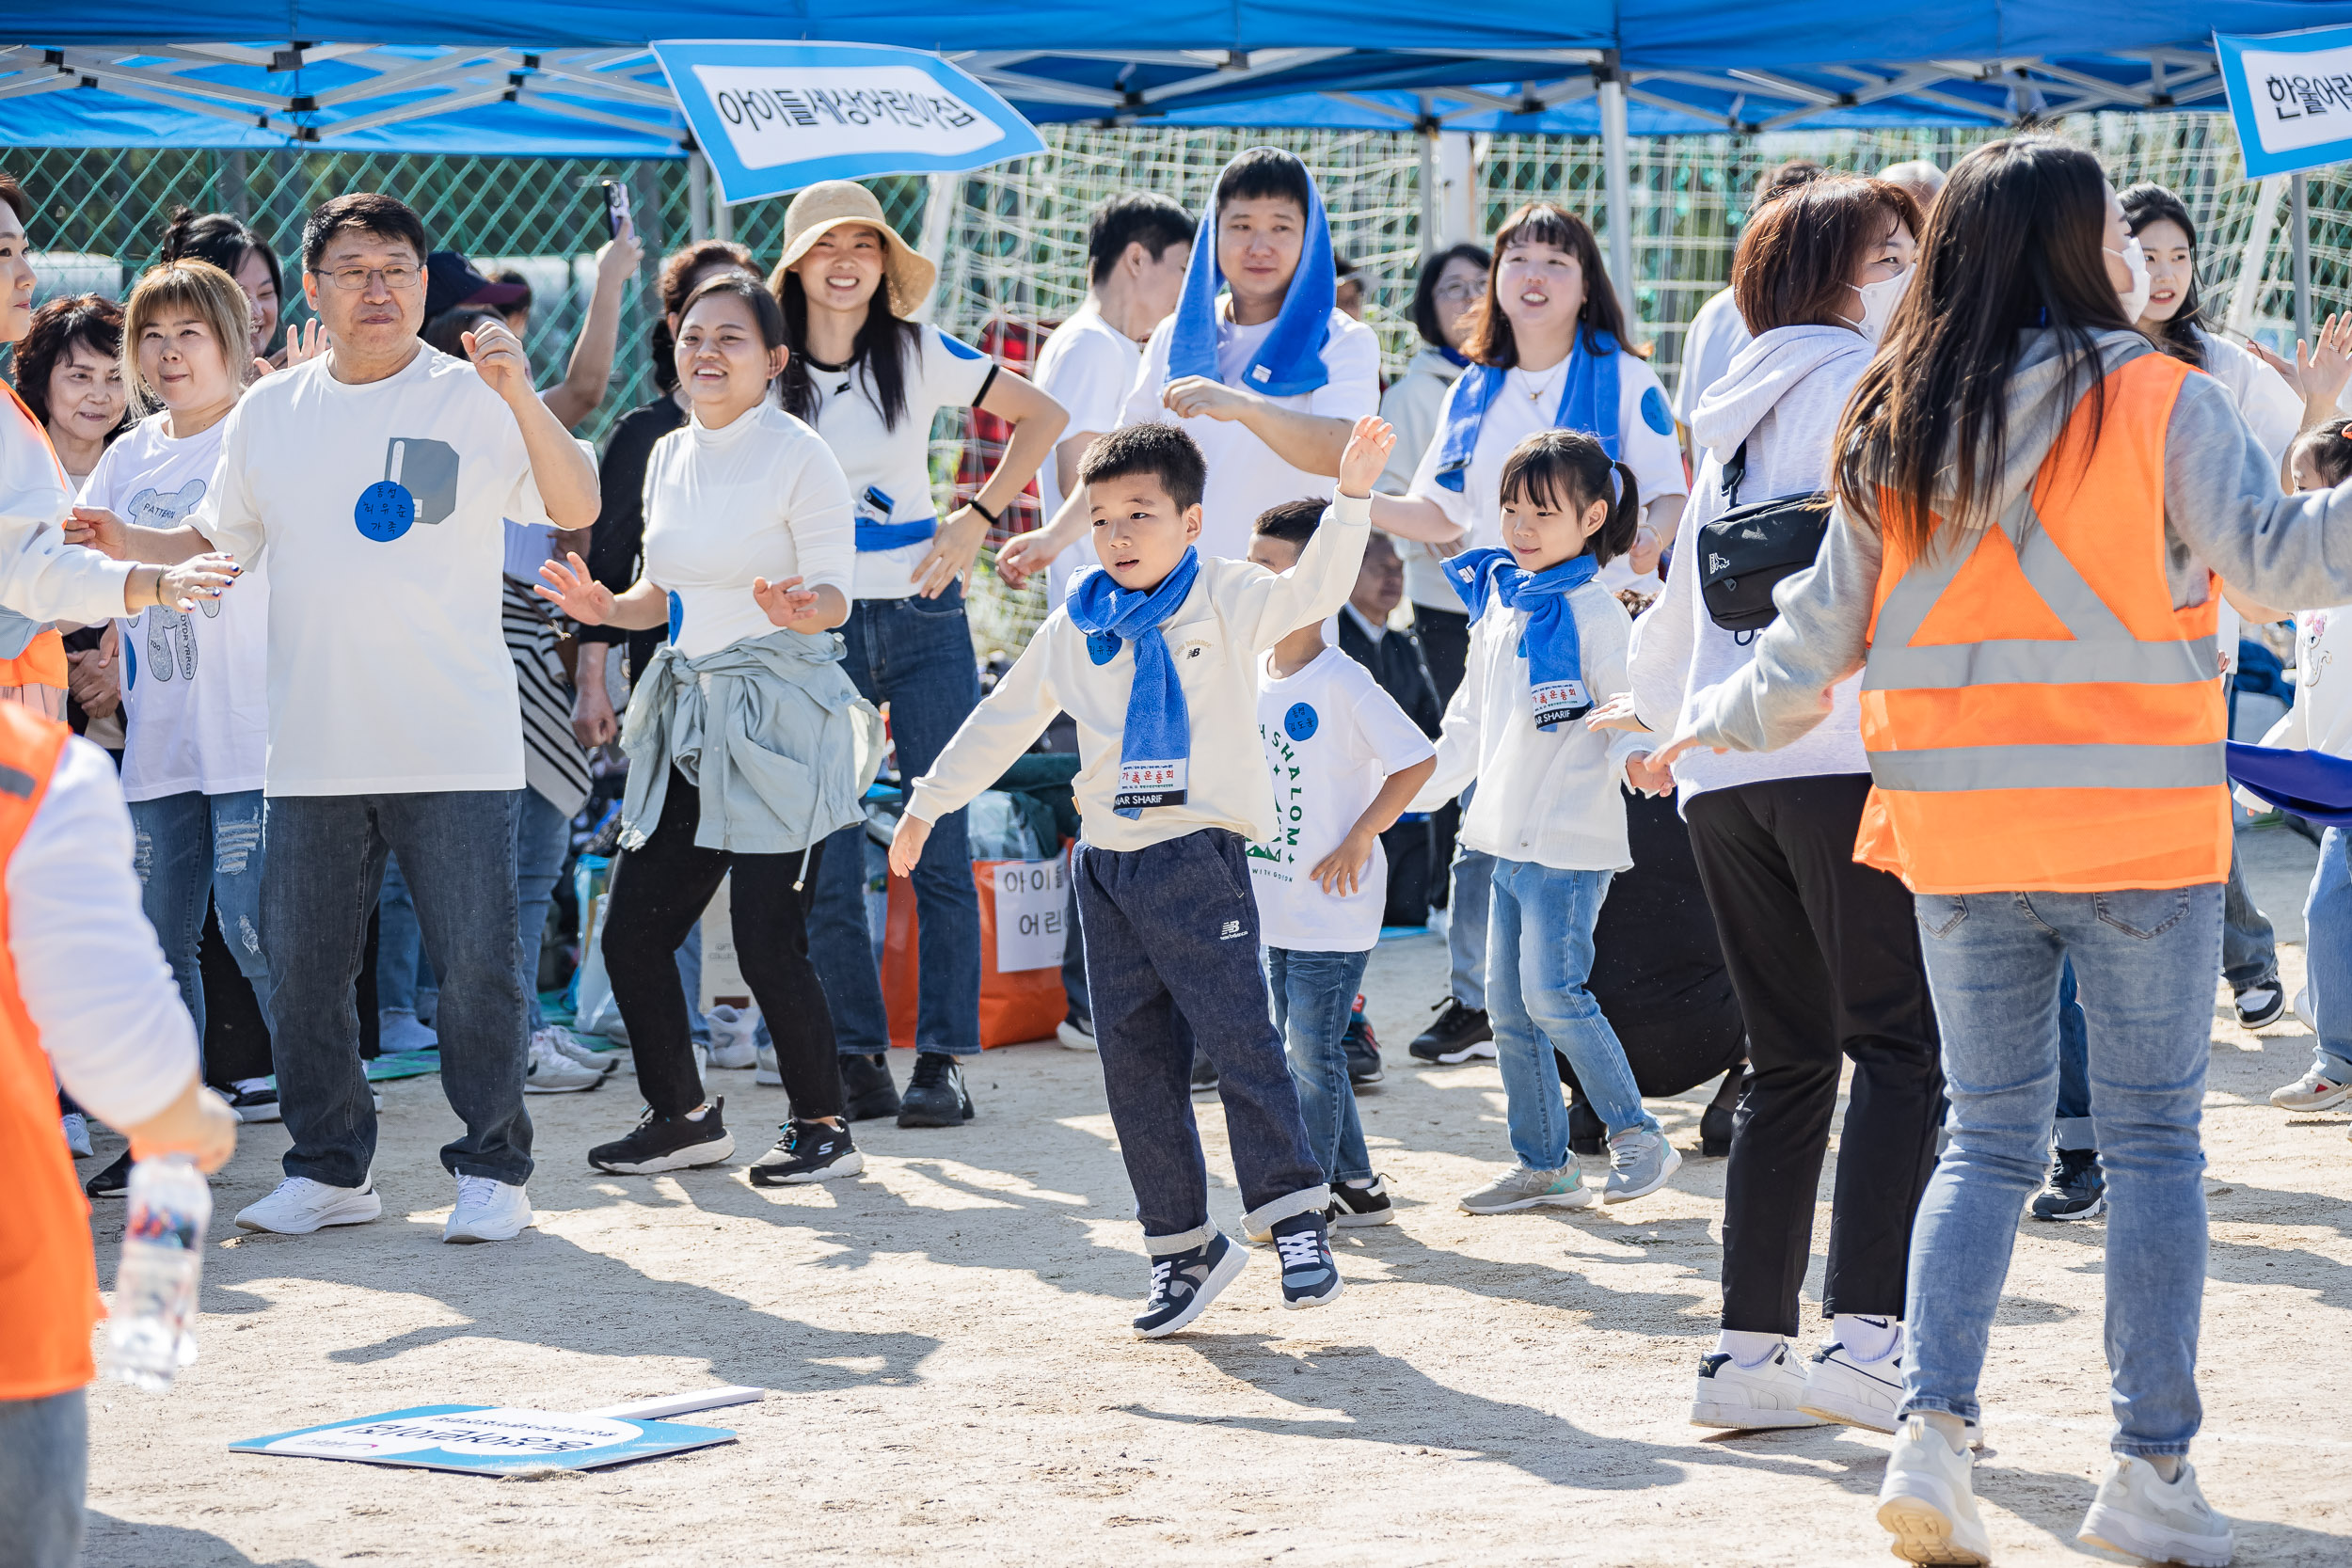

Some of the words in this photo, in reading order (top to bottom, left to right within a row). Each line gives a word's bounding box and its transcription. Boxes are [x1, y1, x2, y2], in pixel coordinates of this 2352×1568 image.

[718, 87, 977, 132] 아이들세상어린이집
[377, 484, 397, 499] 동성
[143, 502, 176, 519] PATTERN
[371, 521, 397, 534] 가족
[1543, 710, 1570, 722] SHARIF
[1122, 768, 1174, 784] 가족운동회
[1271, 731, 1303, 847] SHALOM
[1132, 794, 1163, 805] SHARIF
[342, 1423, 593, 1452] 동성어린이집
